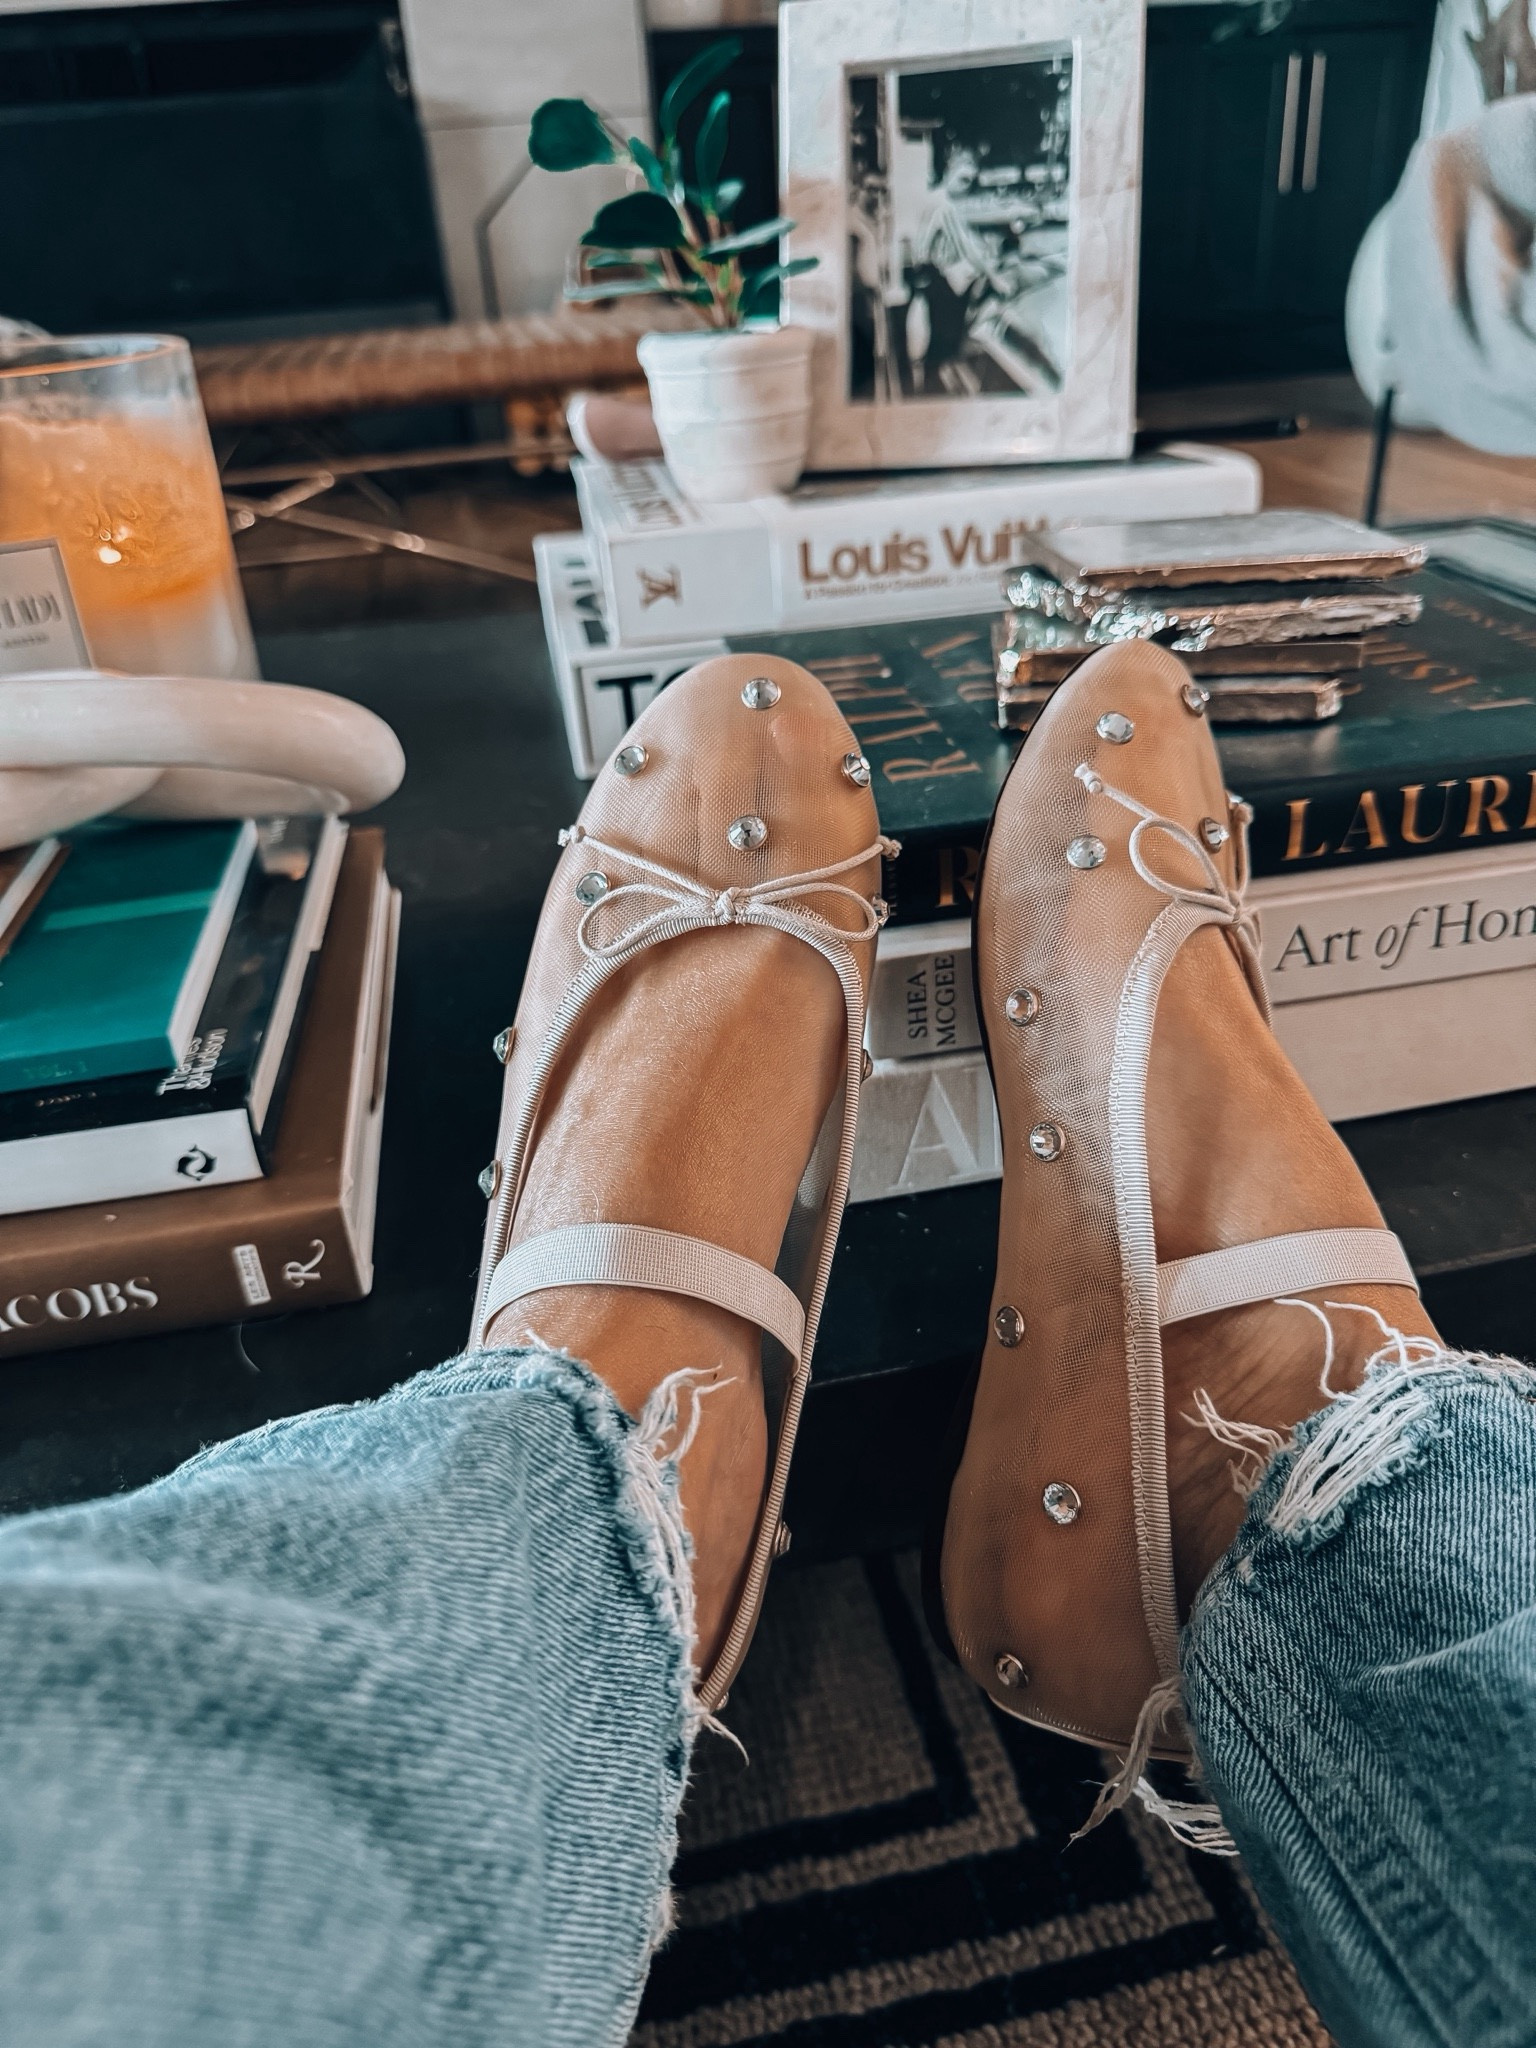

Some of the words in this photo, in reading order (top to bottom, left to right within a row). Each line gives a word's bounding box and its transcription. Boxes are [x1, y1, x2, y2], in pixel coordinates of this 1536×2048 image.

[799, 531, 931, 584] Louis
[1274, 924, 1362, 972] Art
[1375, 905, 1429, 970] of
[908, 969, 929, 1041] SHEA
[934, 954, 956, 1047] MCGEE
